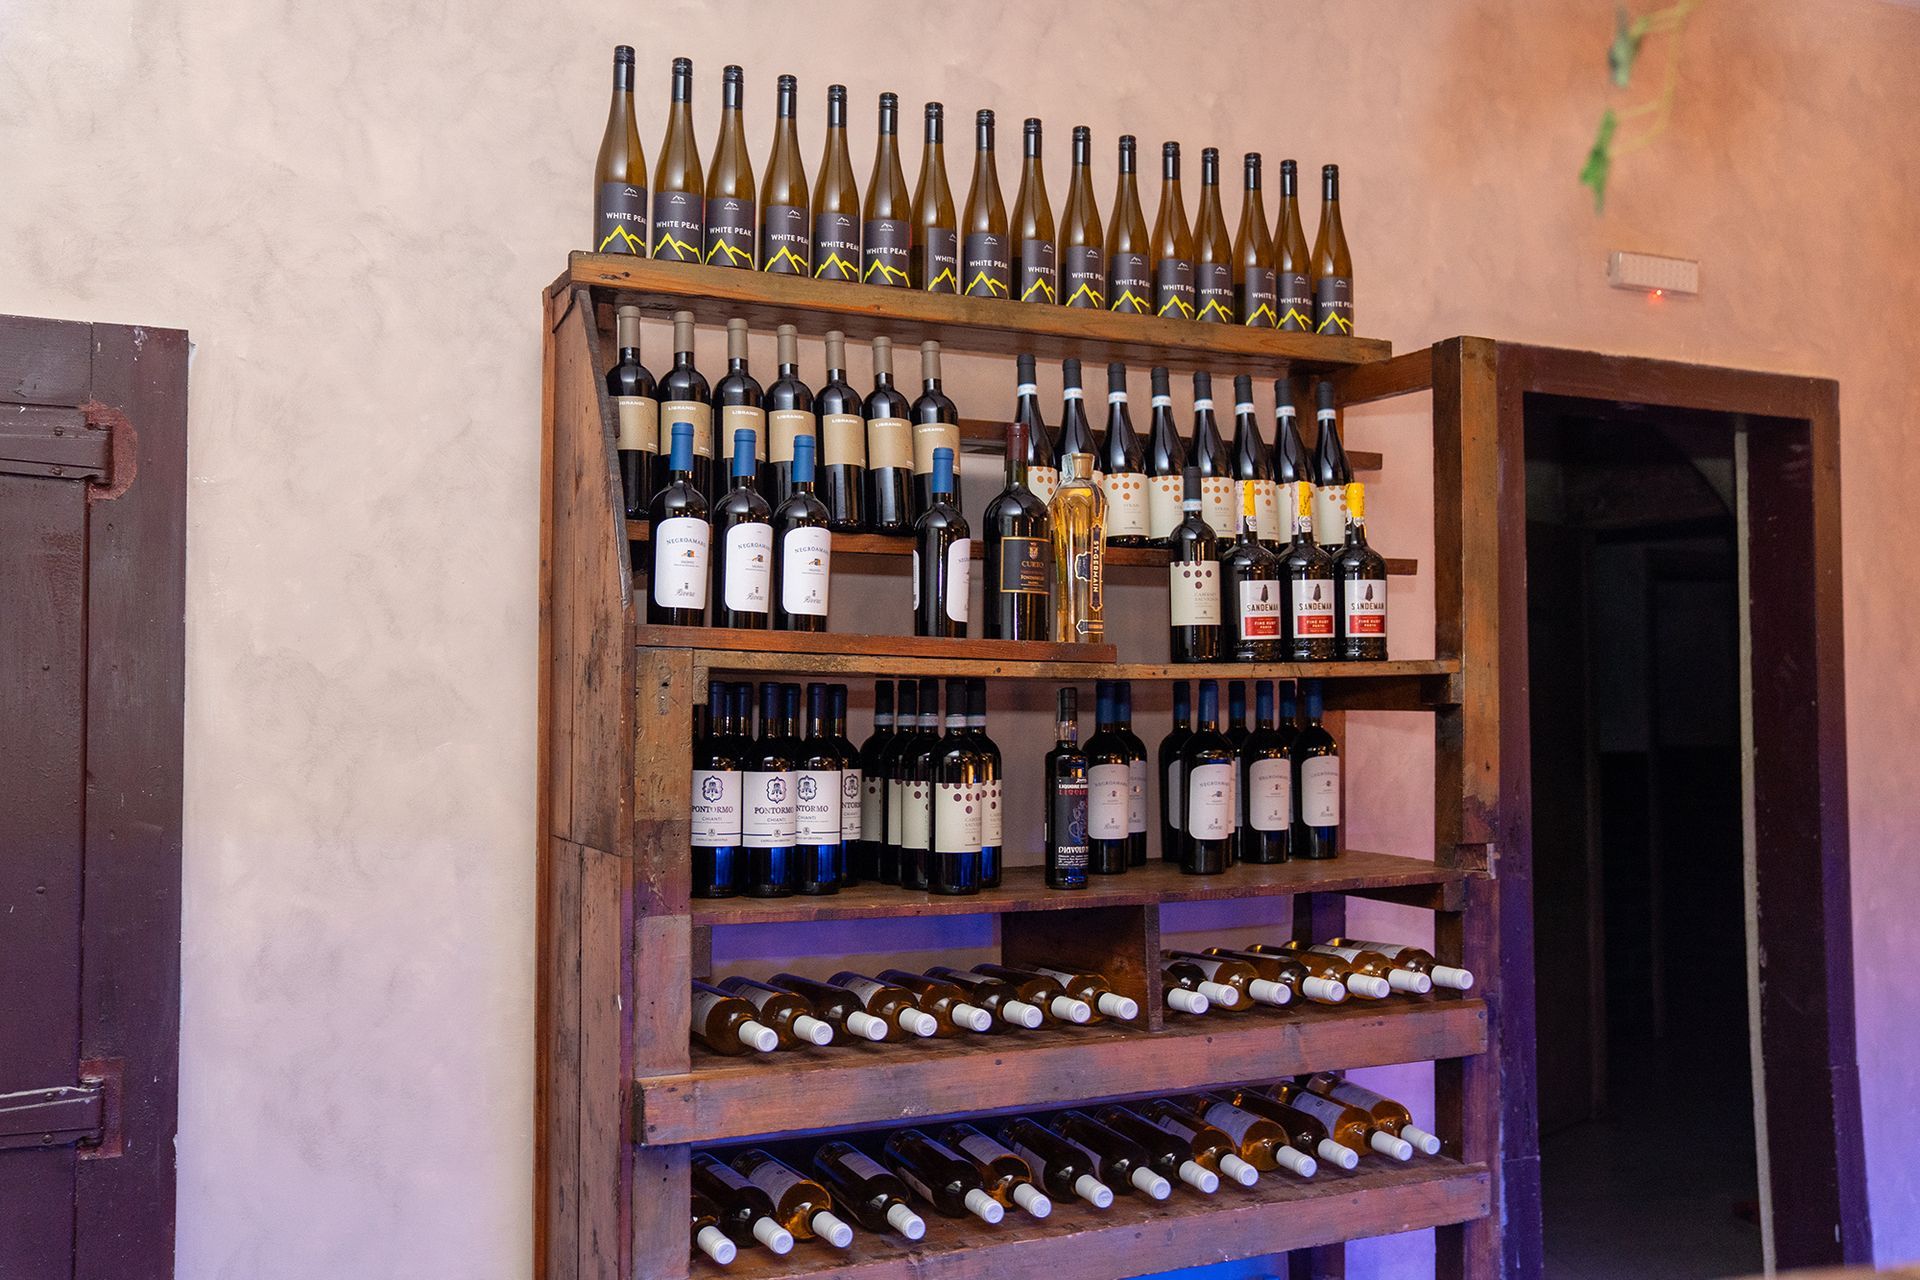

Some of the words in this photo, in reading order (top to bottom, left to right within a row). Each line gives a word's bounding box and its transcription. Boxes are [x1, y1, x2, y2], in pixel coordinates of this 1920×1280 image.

[606, 212, 631, 221] WHITE
[656, 220, 679, 231] WHITE
[681, 222, 699, 231] PEAK
[710, 226, 732, 234] WHITE
[734, 227, 753, 237] PEAK
[770, 234, 795, 242] WHITE
[797, 236, 808, 245] PEA
[821, 241, 844, 250] WHITE
[866, 248, 888, 256] WHITE
[890, 248, 907, 257] PEAK
[935, 255, 955, 264] WHITE
[970, 260, 992, 268] WHITE
[1028, 266, 1049, 274] WHITE
[1072, 272, 1093, 280] WHITE
[1115, 279, 1137, 287] WHITE
[1163, 284, 1184, 292] WHITE
[1201, 289, 1222, 298] WHITE
[1252, 292, 1272, 300] WHITE
[1281, 298, 1301, 306] WHITE
